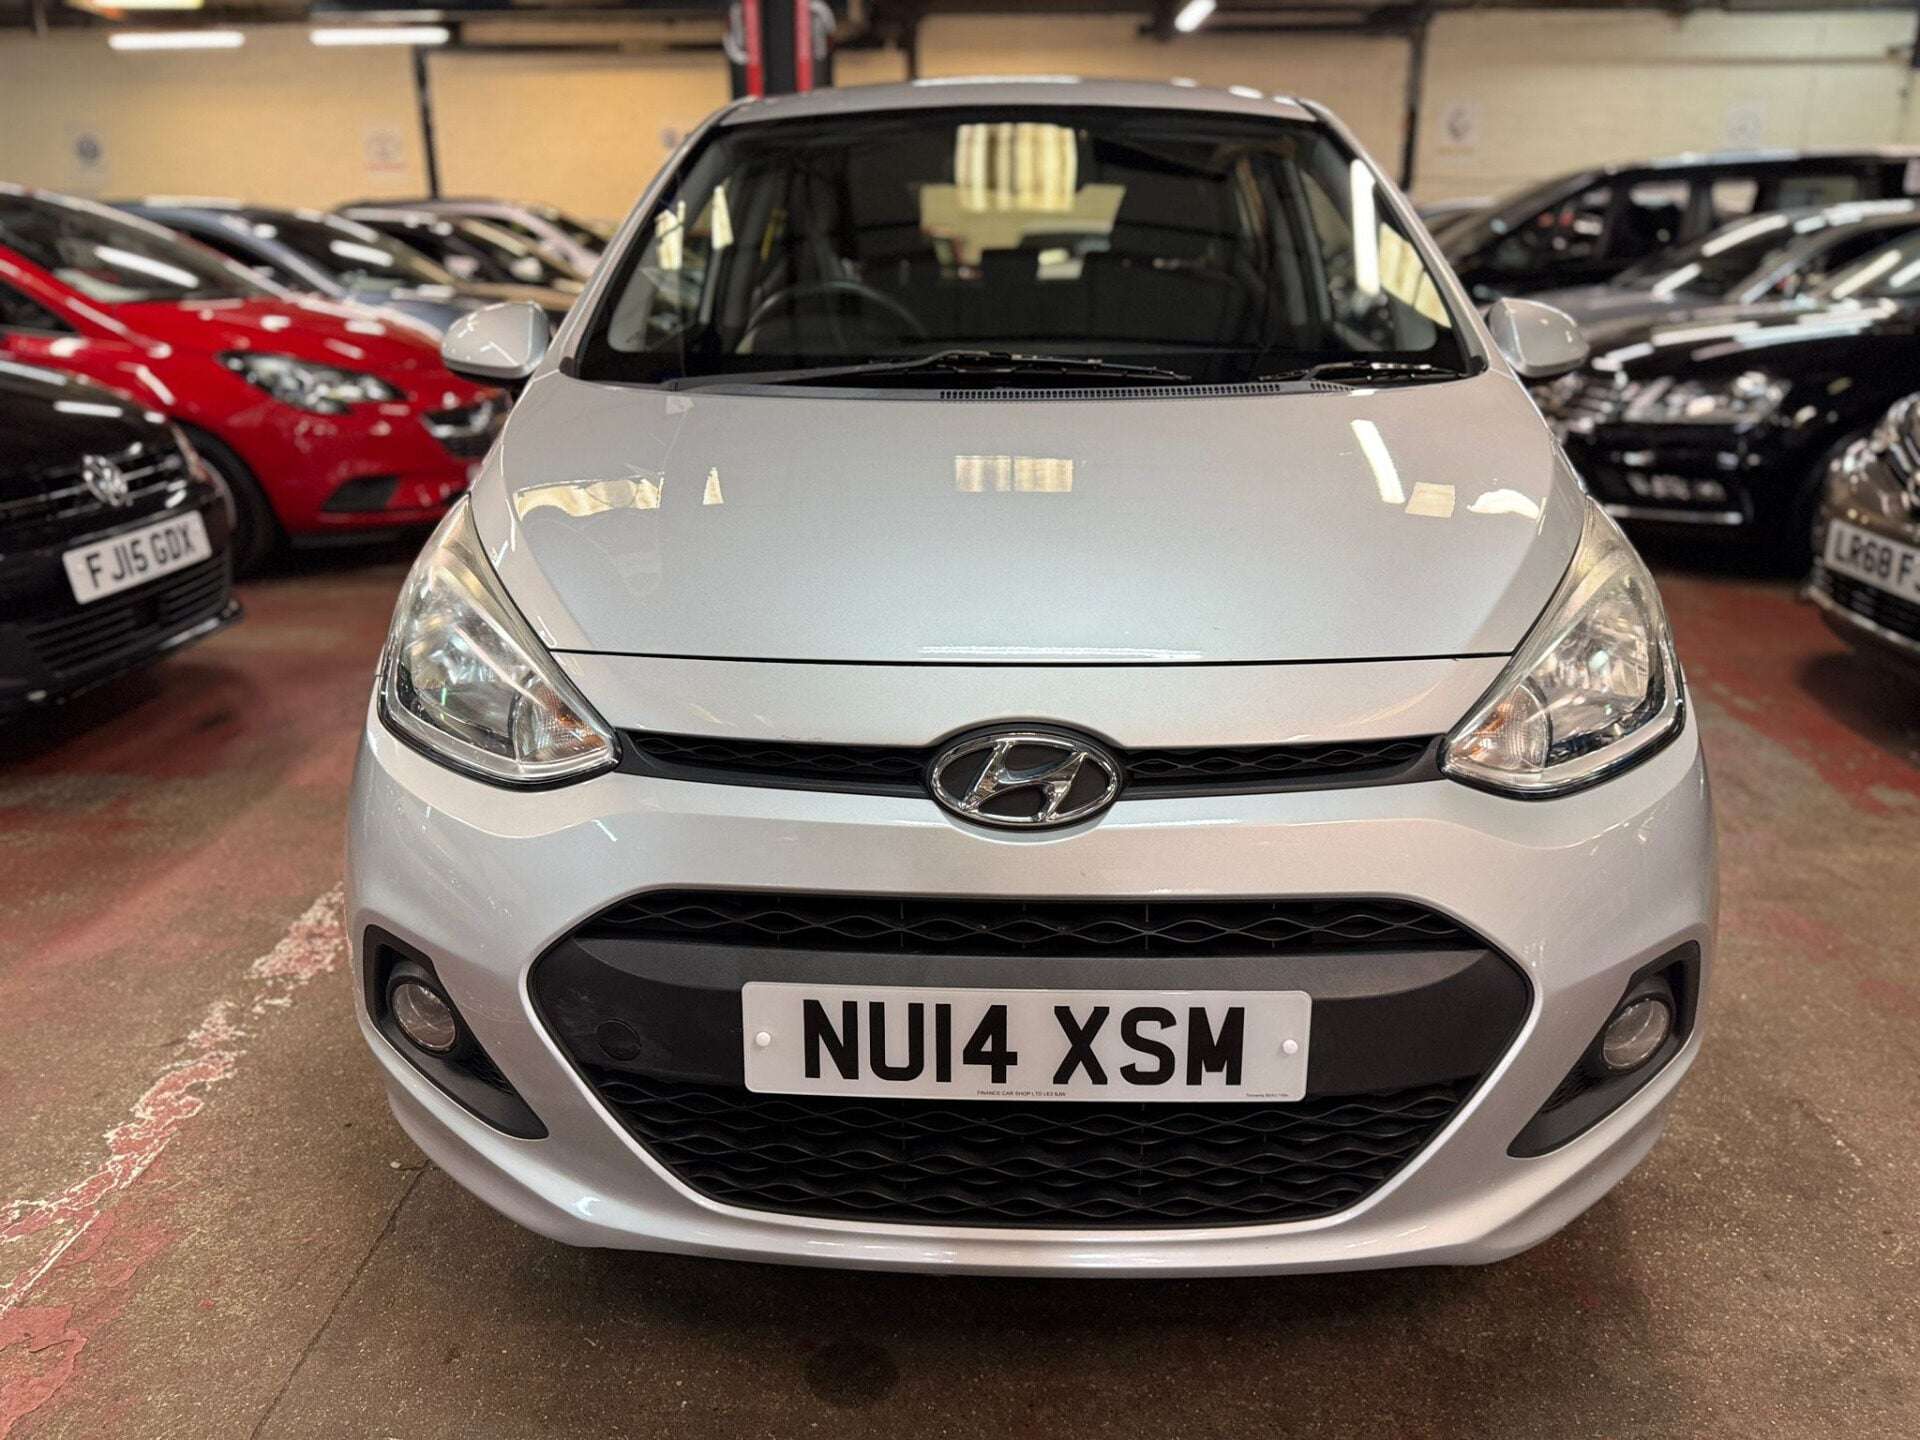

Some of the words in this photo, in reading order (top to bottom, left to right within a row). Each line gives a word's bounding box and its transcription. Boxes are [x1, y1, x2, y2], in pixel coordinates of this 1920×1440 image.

[86, 539, 148, 589] FJ15
[1834, 530, 1893, 578] LR68
[803, 999, 1018, 1084] NU14
[1053, 1006, 1245, 1086] XSM
